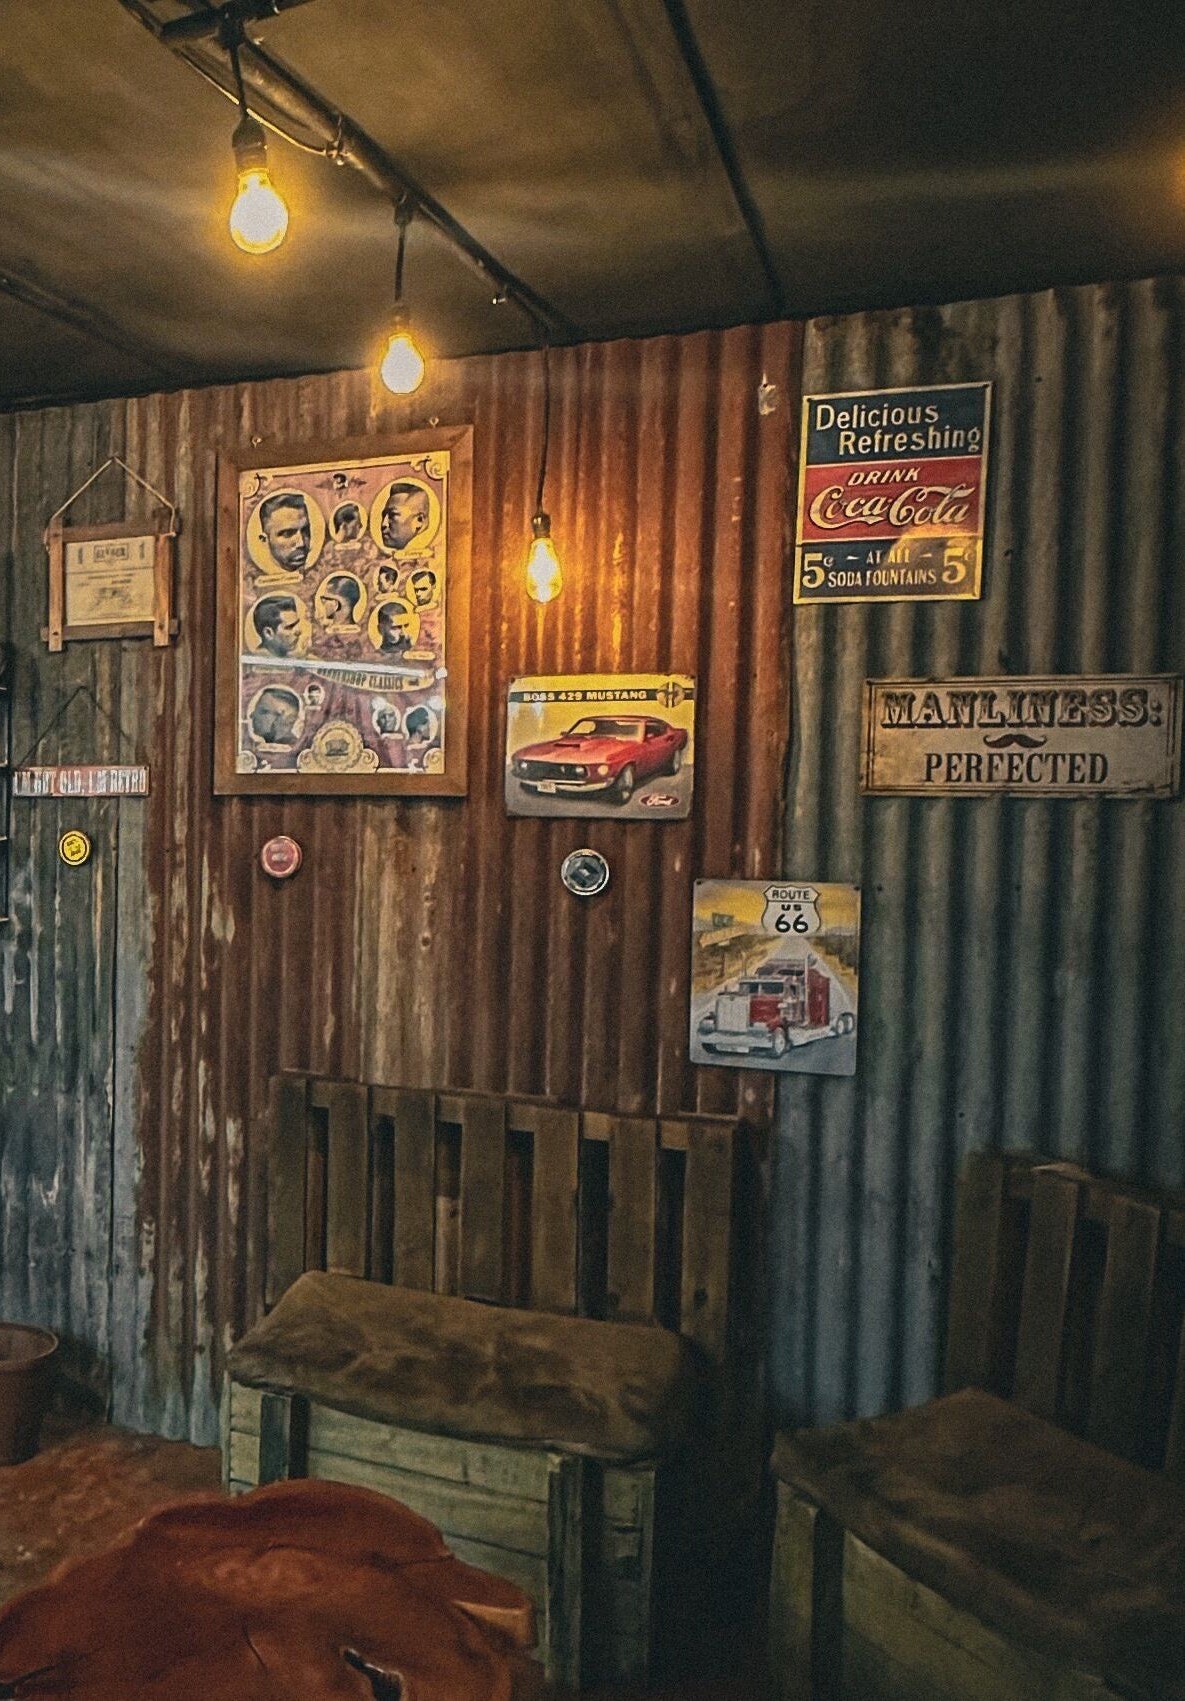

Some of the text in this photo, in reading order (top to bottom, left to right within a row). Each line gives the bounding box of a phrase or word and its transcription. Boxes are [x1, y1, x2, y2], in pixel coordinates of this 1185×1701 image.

[815, 403, 940, 431] Delicious
[838, 425, 981, 455] Refreshing
[847, 467, 921, 487] DRINK
[866, 550, 882, 565] AT
[826, 567, 938, 588] SODA FOUNTAINS
[523, 690, 647, 703] BOSS 429 MUSTANG
[879, 687, 1165, 729] MANLINESS:
[922, 752, 1109, 785] PERFECTED
[645, 795, 674, 807] Ford
[771, 889, 811, 901] ROUTE
[781, 904, 803, 912] US
[774, 914, 809, 934] 66
